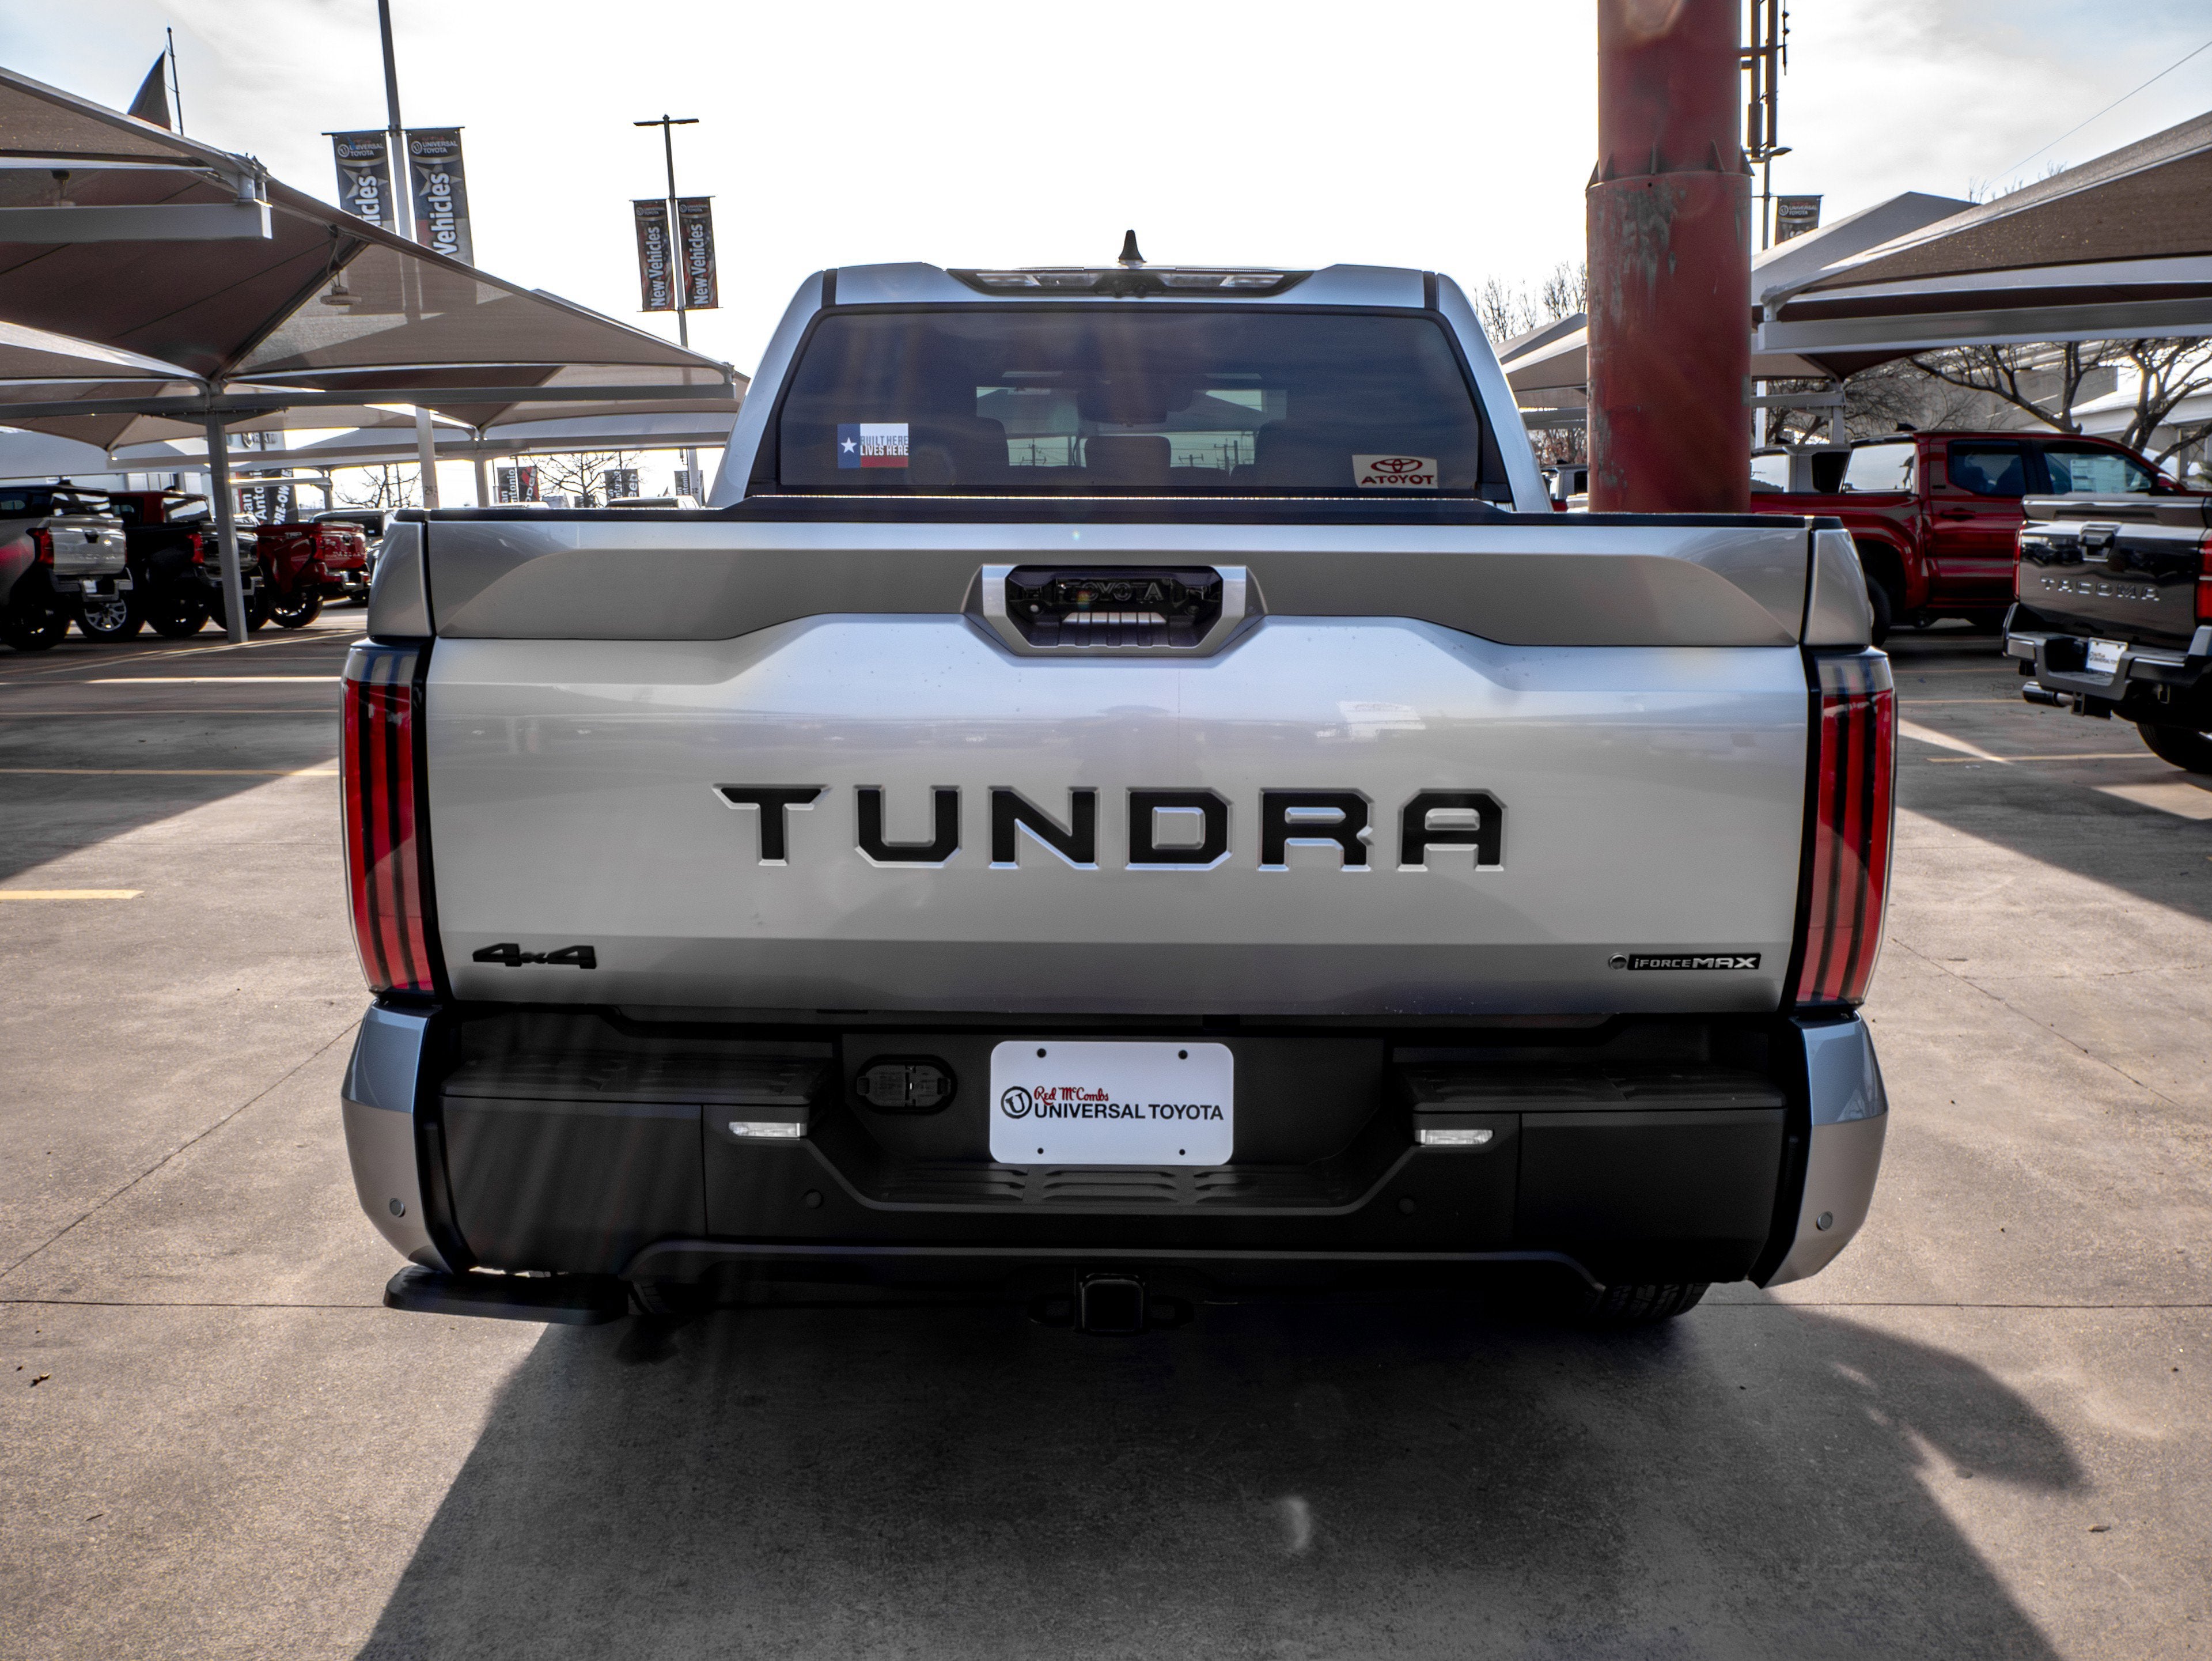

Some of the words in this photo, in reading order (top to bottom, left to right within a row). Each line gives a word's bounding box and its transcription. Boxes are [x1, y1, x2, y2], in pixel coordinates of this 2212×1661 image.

[427, 173, 457, 255] Vehicles
[646, 226, 664, 278] Vehicles
[688, 223, 707, 275] Vehicles
[651, 279, 665, 307] New
[694, 277, 709, 305] New
[860, 436, 885, 446] BUILT
[887, 436, 908, 446] HERE
[860, 445, 884, 456] LIVES
[887, 445, 908, 456] HERE
[2040, 577, 2160, 601] TACOMA
[712, 784, 1509, 872] TUNDRA
[1033, 1085, 1057, 1106] Red
[1058, 1087, 1109, 1102] McCombs
[1035, 1103, 1146, 1119] UNIVERSAL
[1148, 1104, 1224, 1121] TOYOTA
